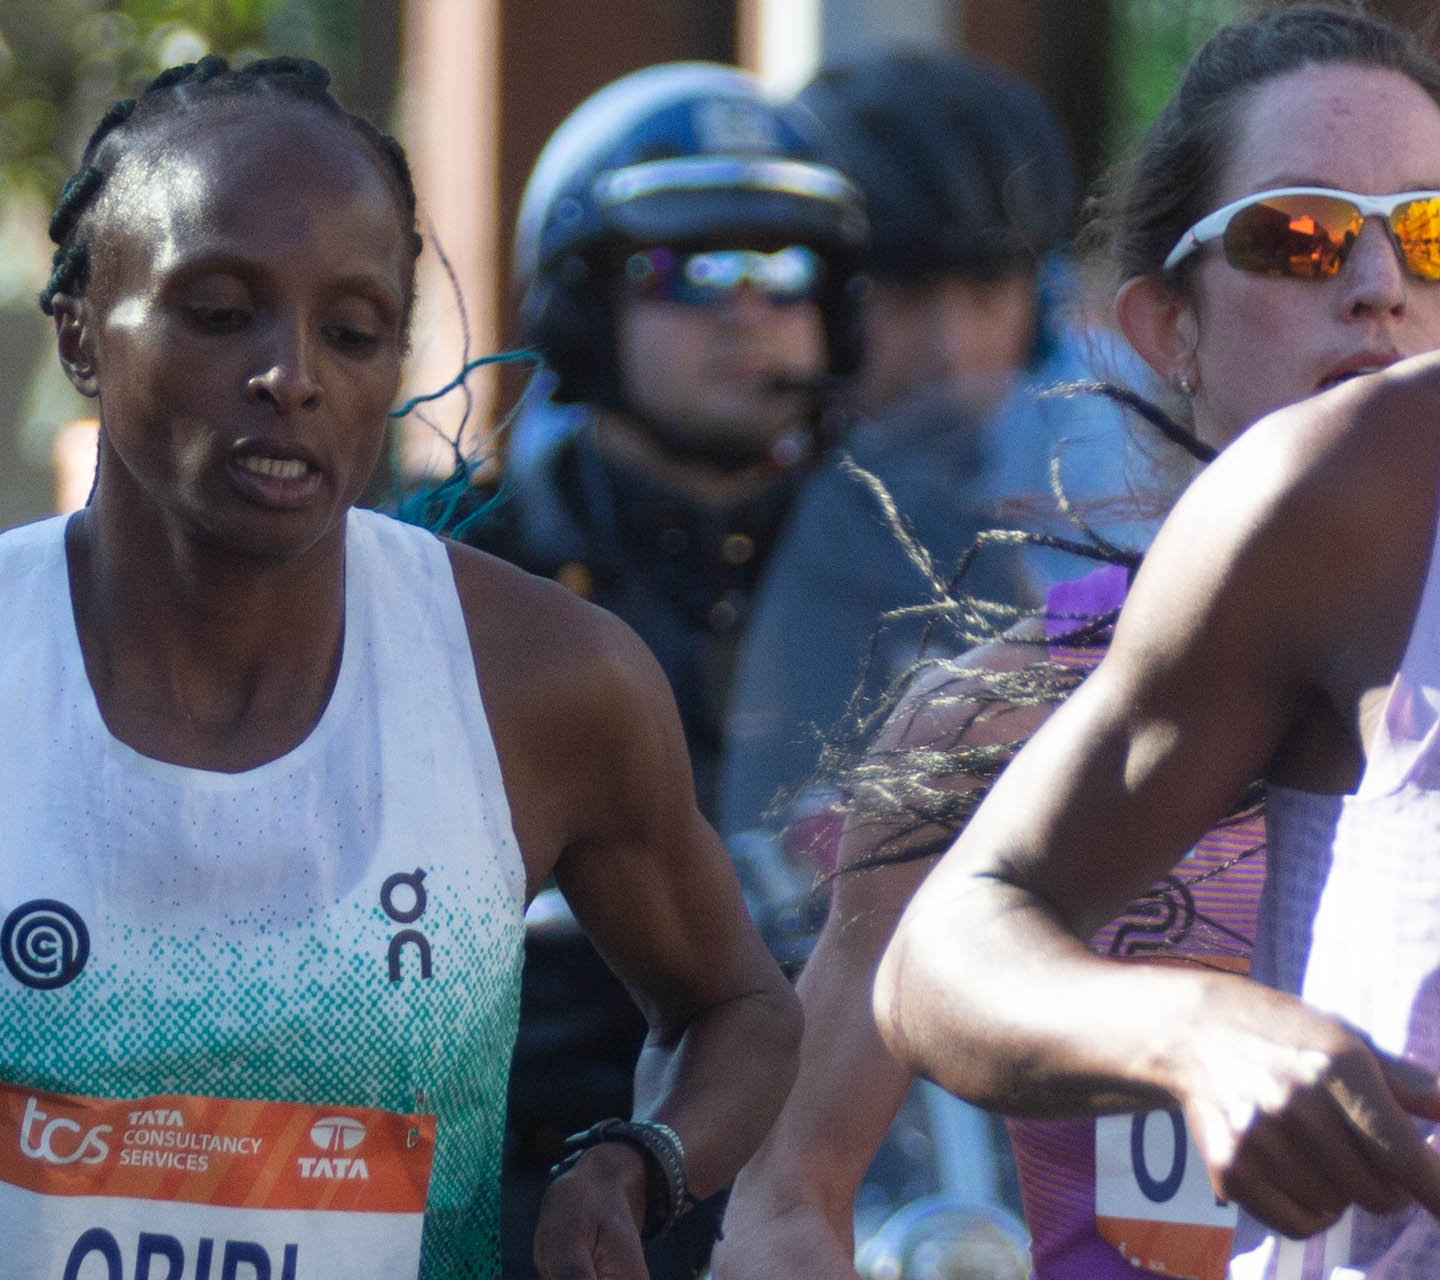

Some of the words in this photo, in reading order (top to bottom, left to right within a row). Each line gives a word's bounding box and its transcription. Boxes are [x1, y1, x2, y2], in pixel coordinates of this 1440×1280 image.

[129, 1109, 184, 1128] TATA
[20, 1096, 112, 1166] tcs
[123, 1129, 263, 1155] CONSULTANCY
[119, 1150, 209, 1172] SERVICES
[298, 1157, 368, 1180] TATA
